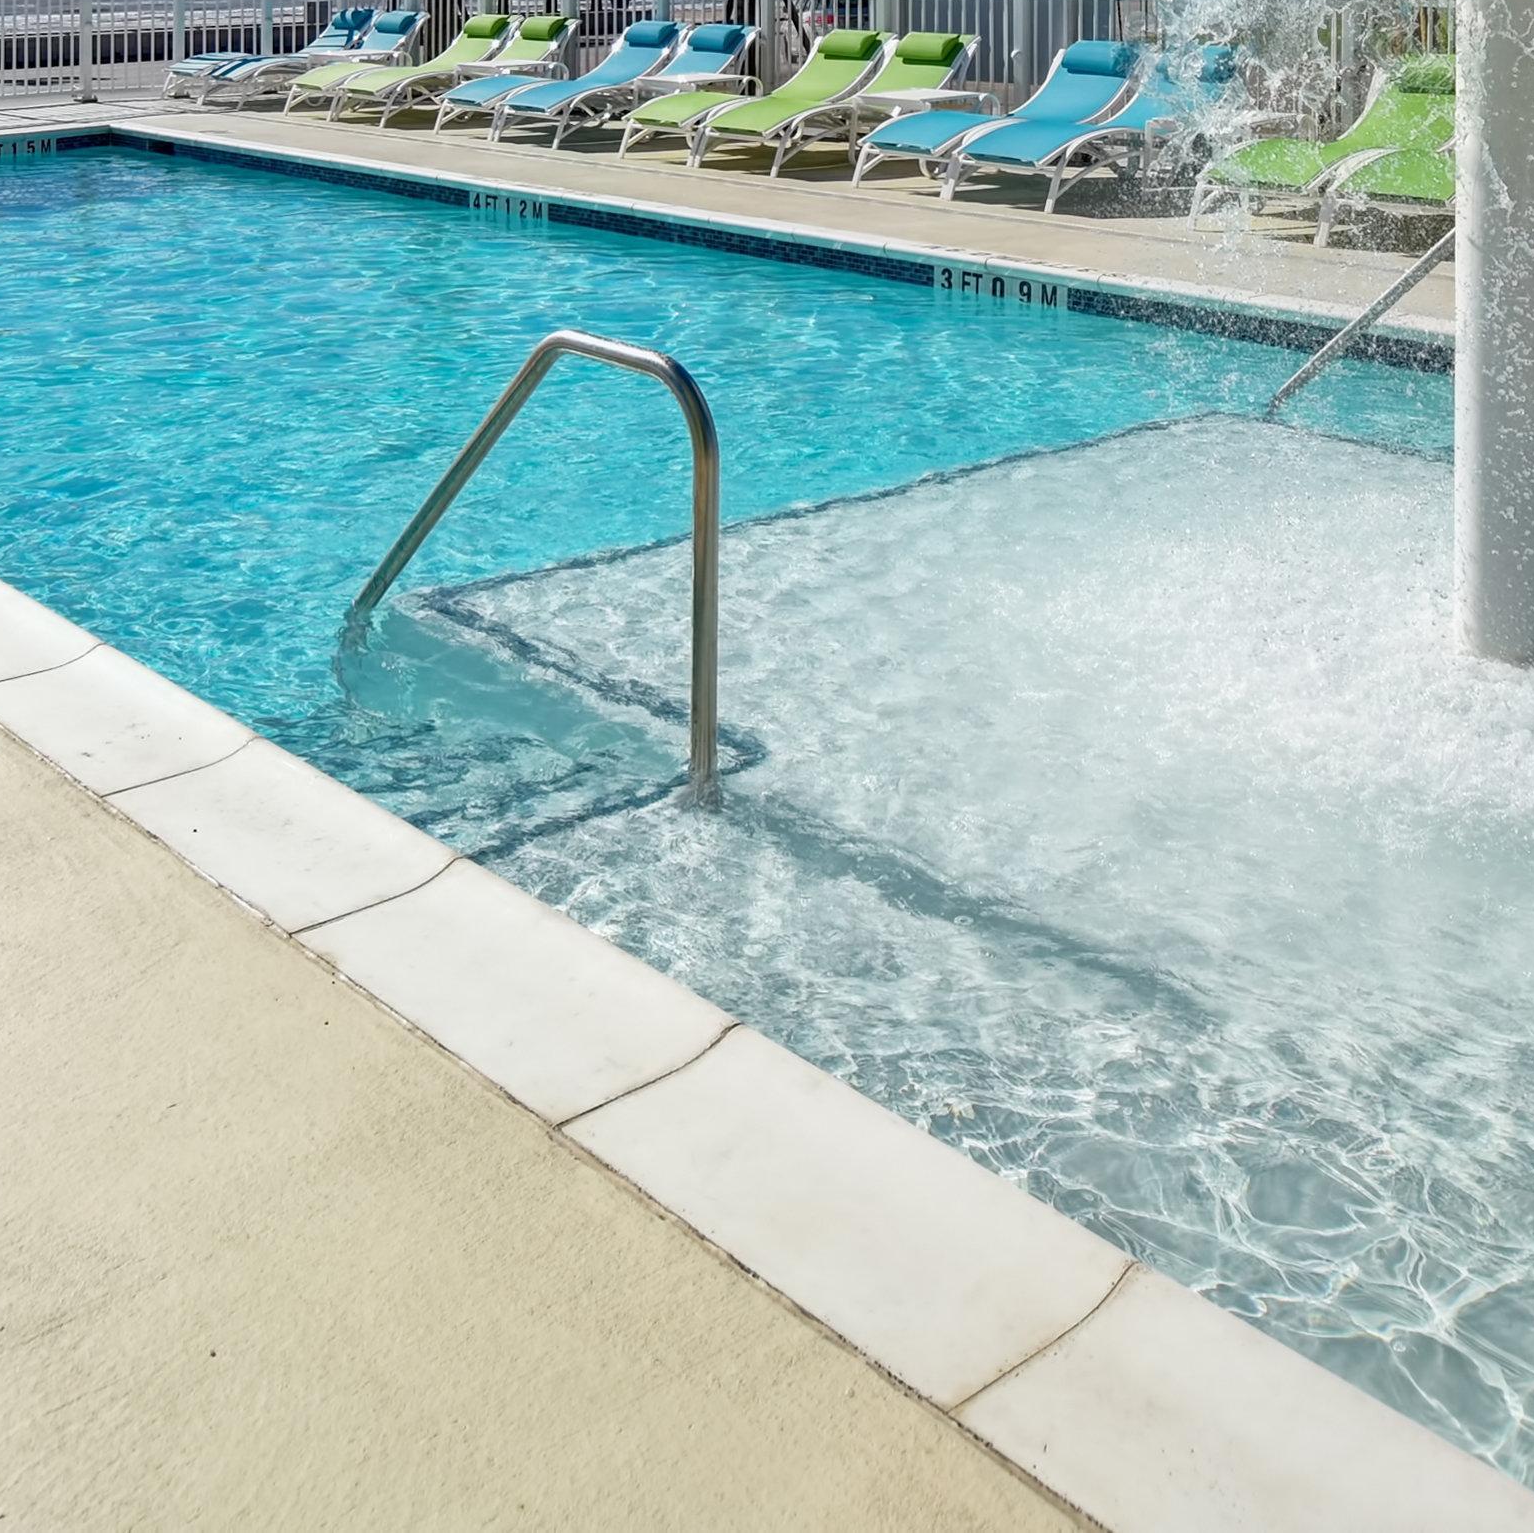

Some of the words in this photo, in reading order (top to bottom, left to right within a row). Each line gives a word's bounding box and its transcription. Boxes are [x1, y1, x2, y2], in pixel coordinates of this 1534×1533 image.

[12, 142, 17, 155] 1
[27, 140, 35, 153] 5
[41, 139, 51, 153] M
[473, 193, 480, 209] 4
[485, 195, 498, 210] FT
[506, 197, 510, 215] 1
[519, 200, 527, 219] 2
[533, 202, 542, 219] M
[941, 268, 953, 289] 3
[961, 271, 983, 295] FT
[992, 277, 1005, 298] 0
[1019, 281, 1032, 304] 9
[1041, 284, 1058, 308] M
